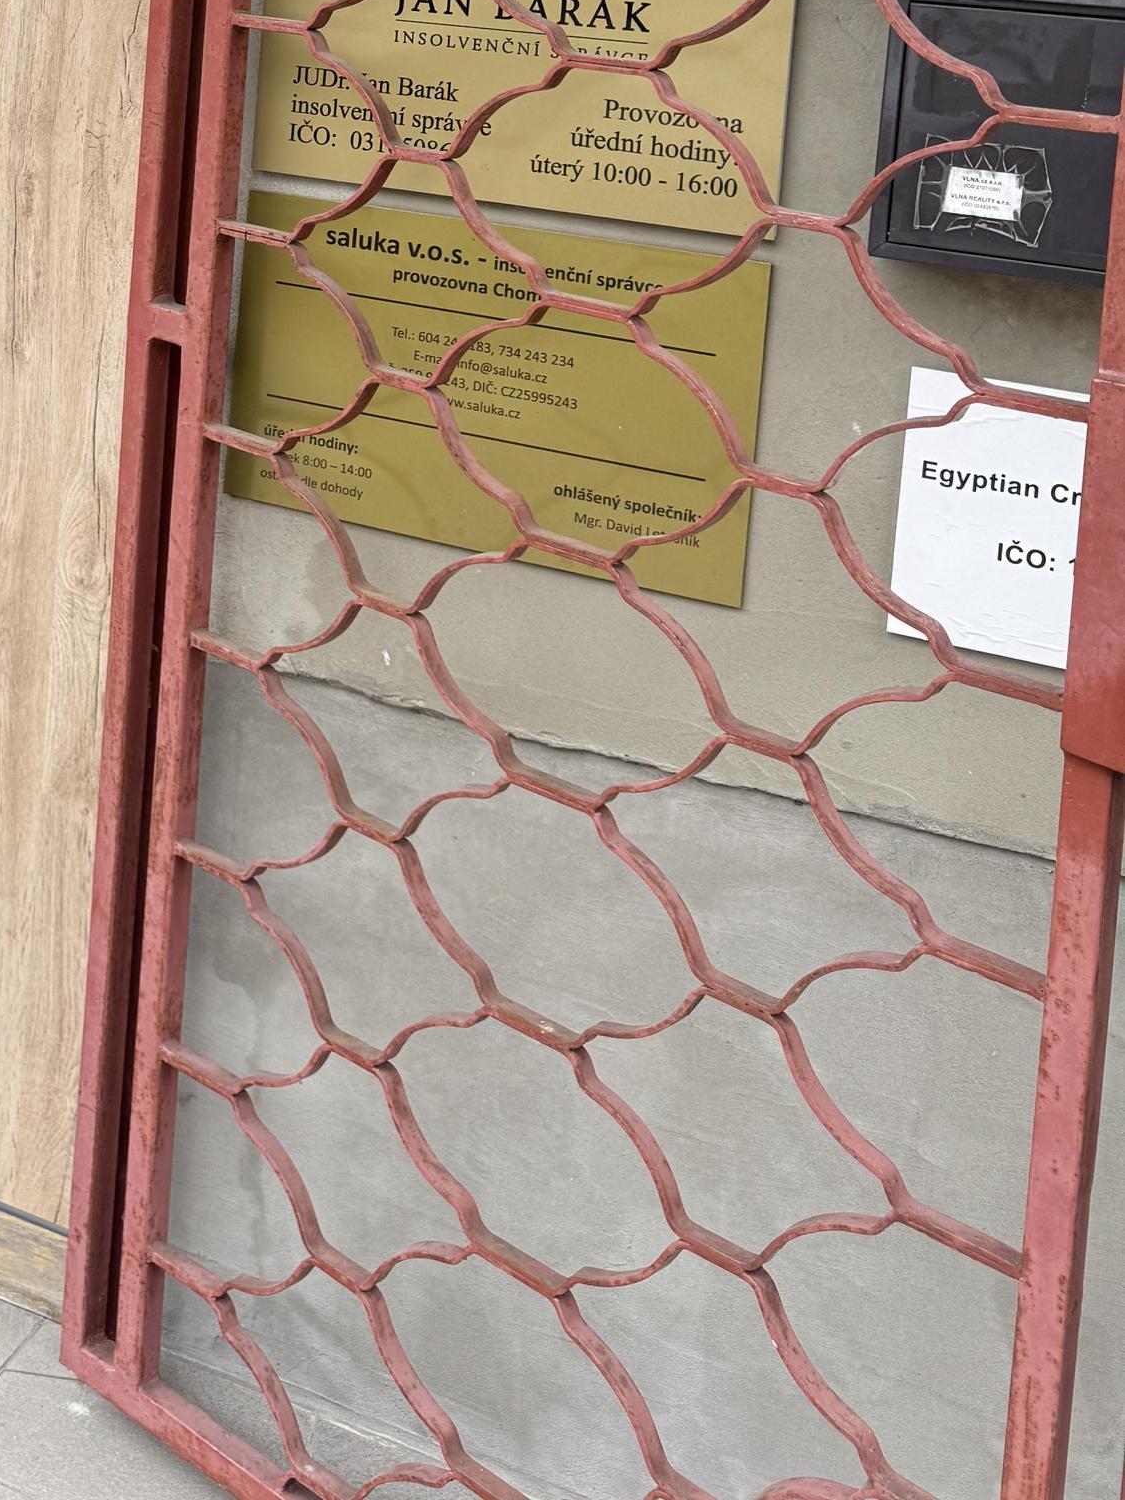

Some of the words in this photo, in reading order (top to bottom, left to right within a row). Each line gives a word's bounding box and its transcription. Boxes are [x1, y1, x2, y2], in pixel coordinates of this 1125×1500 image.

[394, 30, 541, 57] INSOLVENČNÍ
[293, 65, 350, 90] JUDr.
[362, 72, 391, 95] an
[397, 77, 460, 101] Barák
[291, 94, 406, 126] insolvenní
[411, 113, 492, 136] správe
[602, 98, 744, 134] Provozona
[288, 119, 337, 147] IČO:
[570, 127, 644, 155] úřední
[530, 154, 584, 182] úterý
[592, 162, 652, 187] 10:00
[676, 172, 738, 198] 16:00
[326, 227, 400, 255] saluka
[408, 241, 470, 266] v.o.s.
[493, 256, 593, 285] insenční
[393, 269, 488, 294] provozovna
[391, 327, 416, 340] Tel.:
[418, 331, 440, 344] 604
[498, 345, 521, 359] 734
[524, 349, 548, 364] 243
[551, 354, 574, 368] 234
[447, 397, 521, 419] ww.saluka.cz
[473, 380, 498, 395] DIČ:
[501, 386, 578, 410] CZ25995243
[309, 434, 358, 455] hodiny:
[302, 455, 328, 470] 8:00
[341, 463, 373, 479] 14:00
[921, 460, 1039, 499] Egyptian
[320, 481, 364, 501] dohody
[554, 484, 621, 510] ohlášený
[574, 512, 602, 529] Mgr.
[606, 518, 642, 536] David
[997, 540, 1055, 572] IČO:
